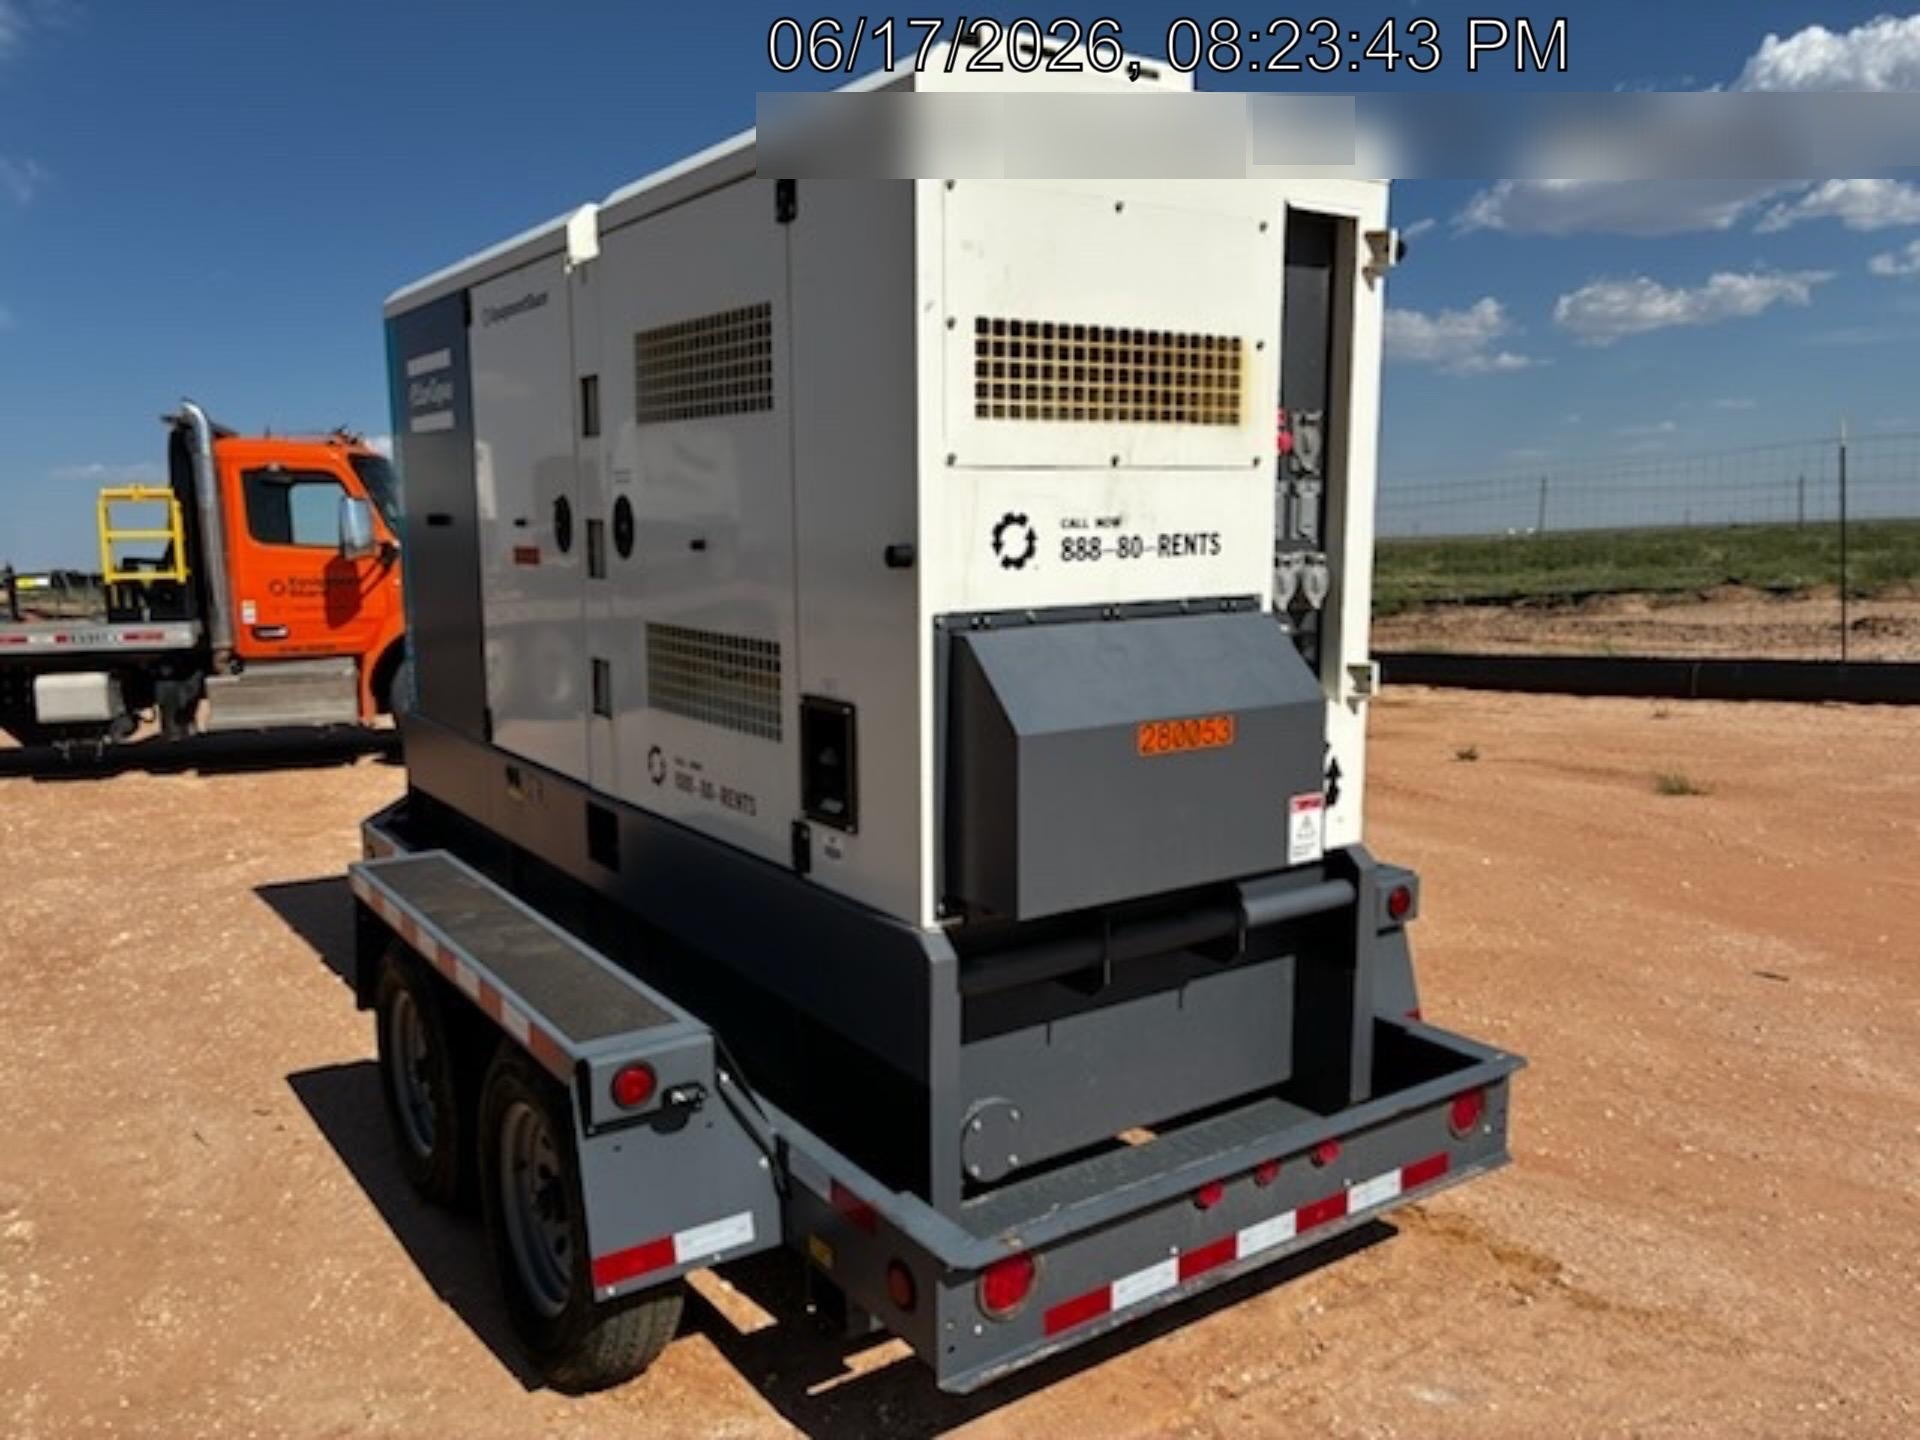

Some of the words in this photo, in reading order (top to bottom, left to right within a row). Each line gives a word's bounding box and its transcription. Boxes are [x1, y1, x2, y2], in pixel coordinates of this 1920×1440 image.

[1060, 518, 1089, 529] CALL
[1094, 516, 1122, 528] NOW
[1061, 533, 1221, 561] 888-80-RENTS
